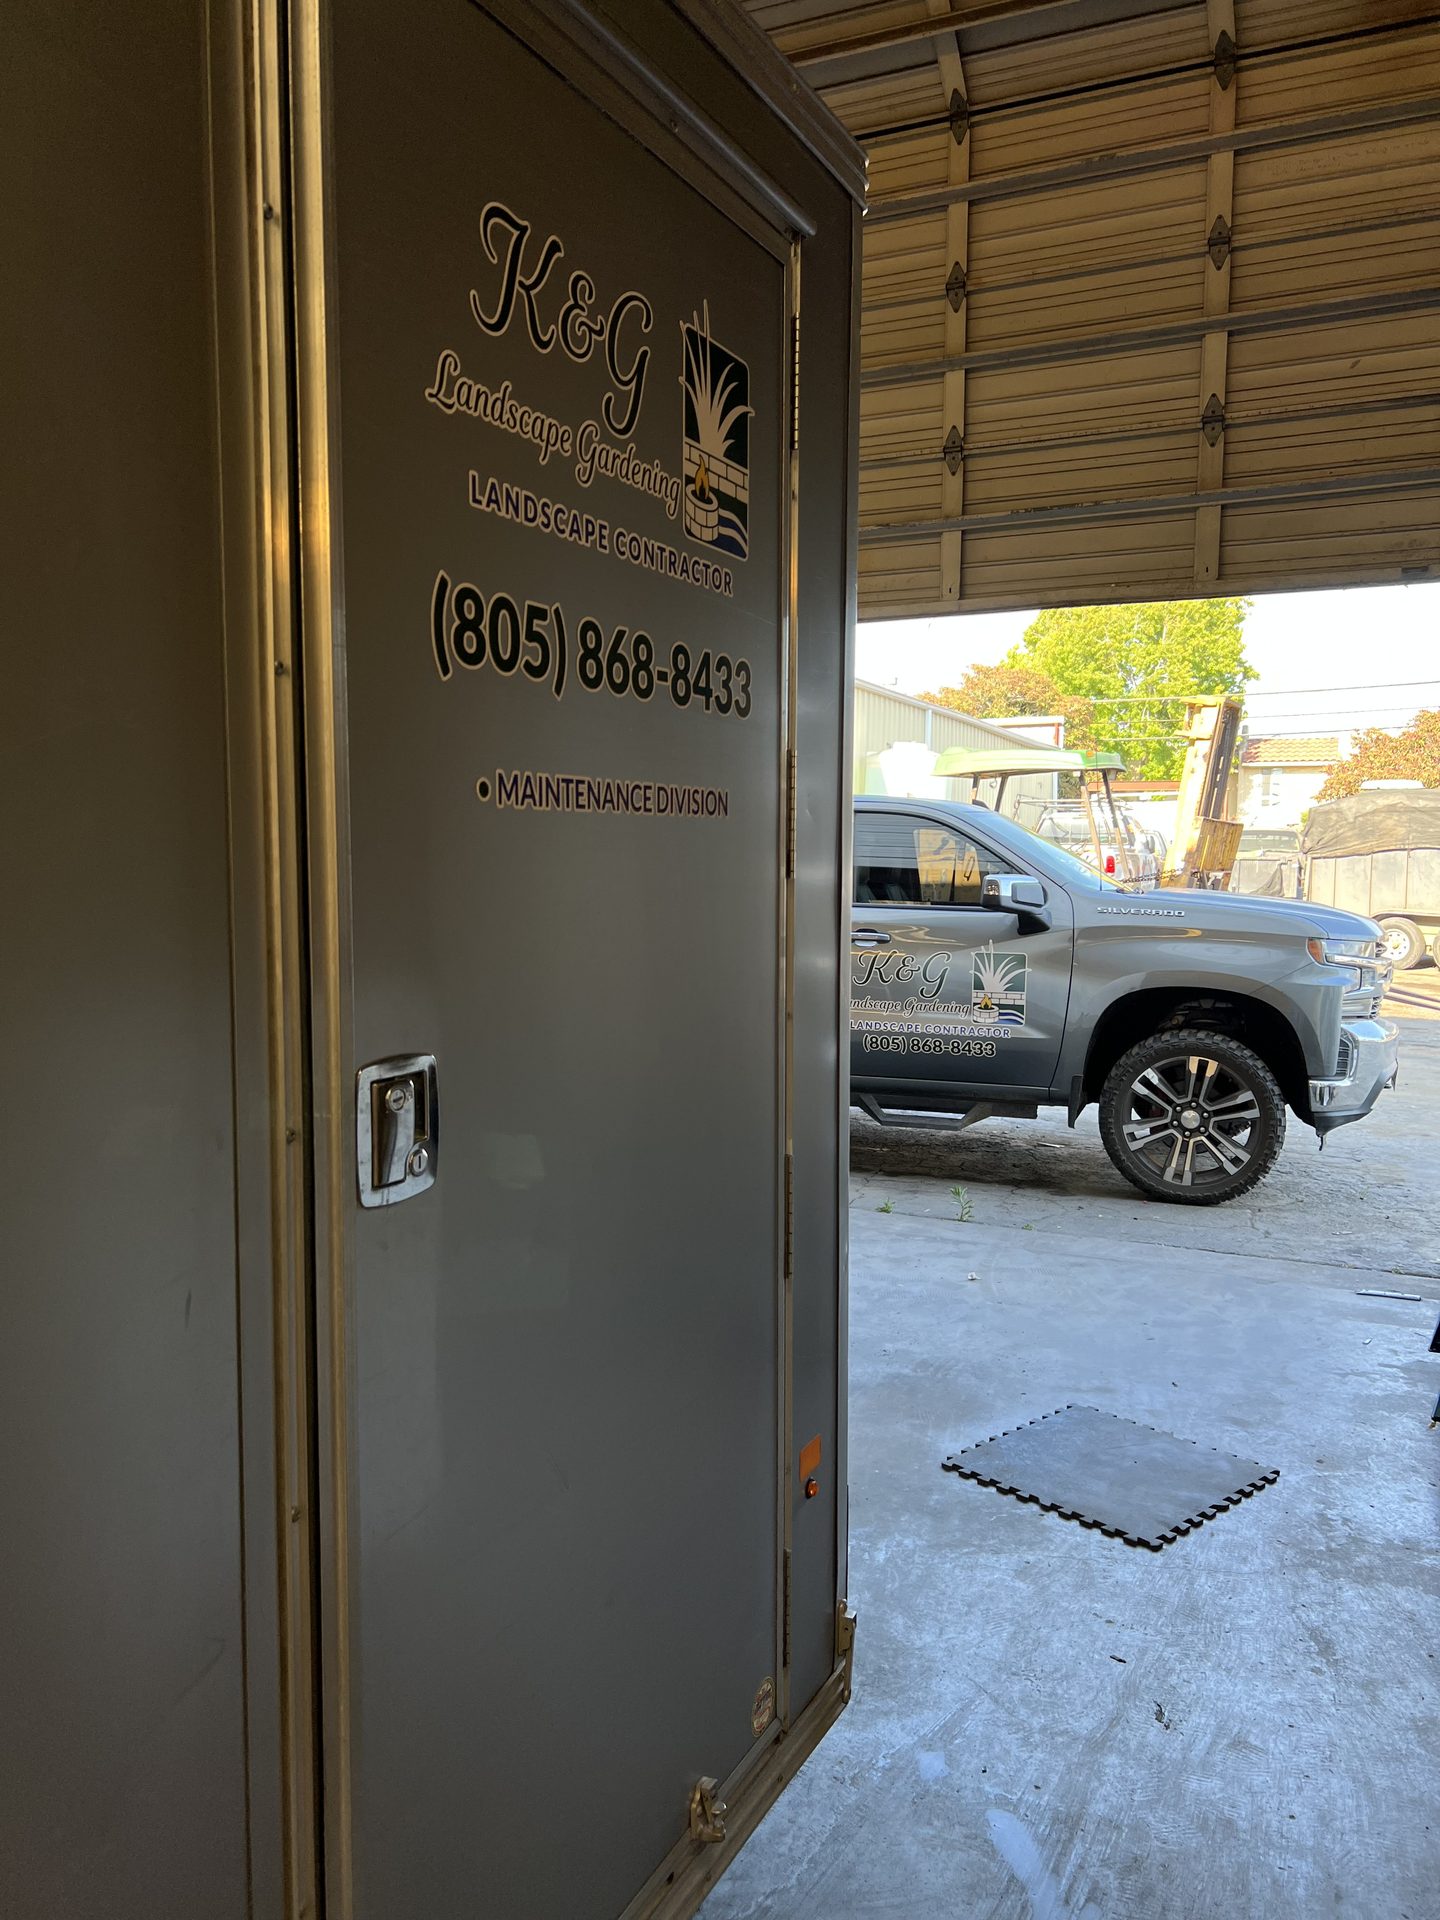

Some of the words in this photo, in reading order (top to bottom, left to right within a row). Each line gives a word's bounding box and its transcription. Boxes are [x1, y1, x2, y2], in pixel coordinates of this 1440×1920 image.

[470, 201, 653, 437] K&G
[425, 349, 572, 464] Landscape
[575, 419, 682, 520] Gardening
[469, 470, 609, 554] LANDSCAPE
[614, 530, 733, 596] CONTRACTOR
[431, 569, 568, 701] (805)
[577, 615, 752, 720] 868-8433
[496, 769, 653, 814] MAINTENANCE
[655, 785, 730, 818] DIVISION
[1097, 906, 1185, 918] SILVERADO
[852, 949, 952, 999] K&G
[850, 996, 901, 1015] ndscape
[903, 997, 970, 1018] Gardening
[850, 1020, 921, 1033] LANDSCAPE
[924, 1024, 1011, 1039] CONTRACTOR
[863, 1034, 907, 1054] (805)
[910, 1037, 996, 1058] 868-8433
